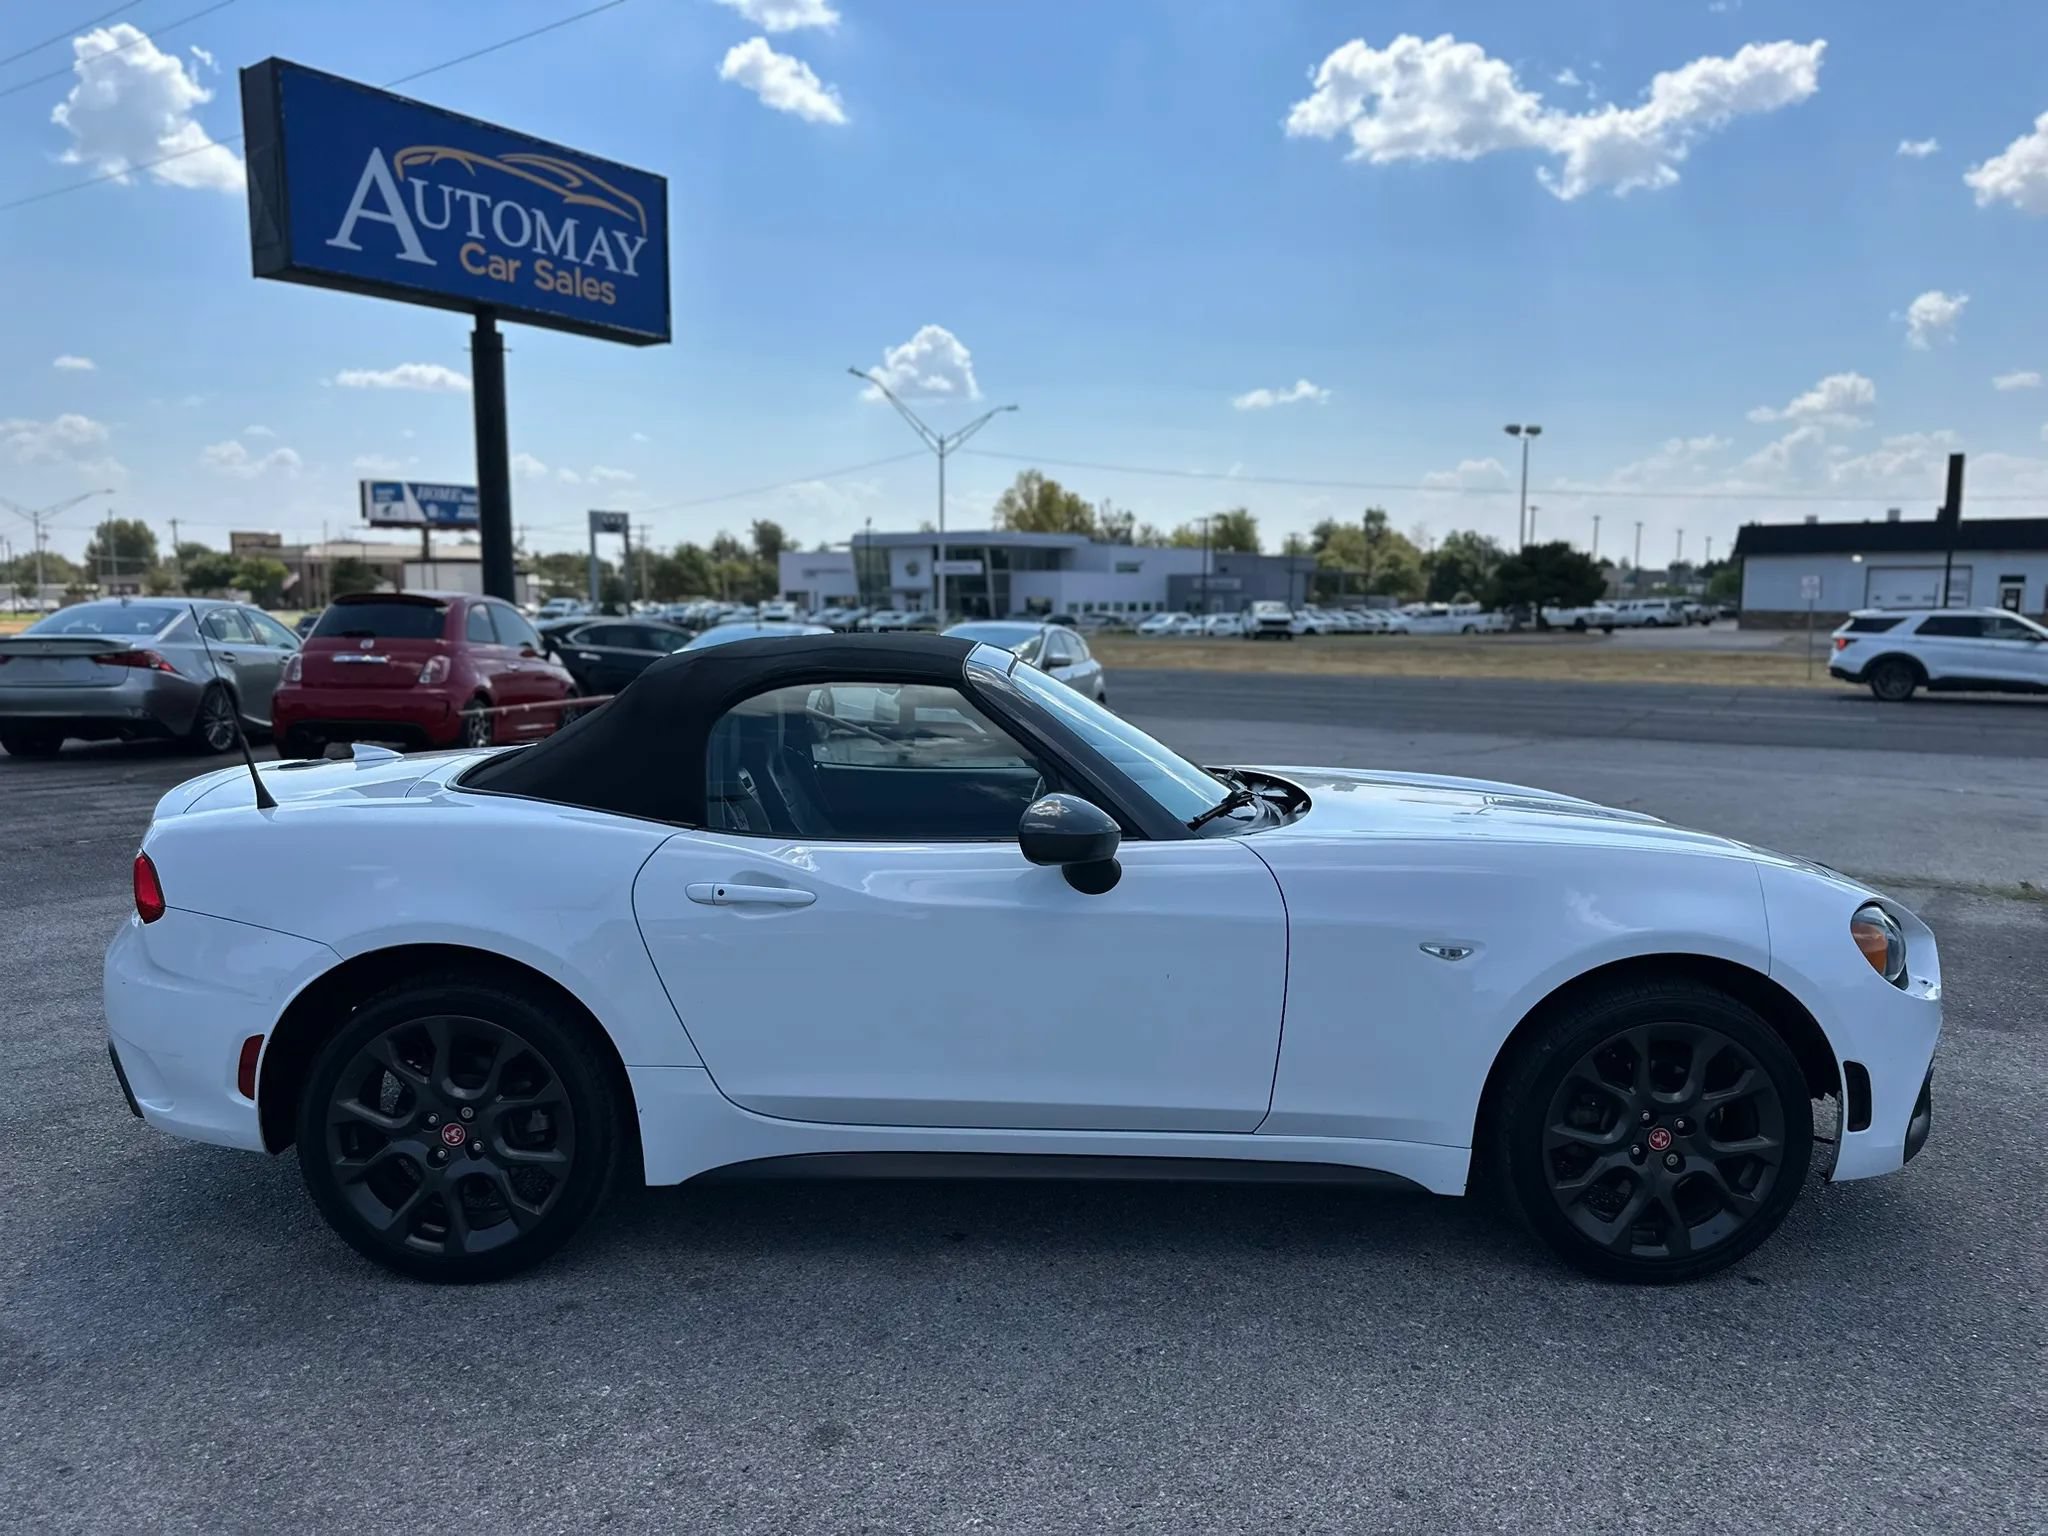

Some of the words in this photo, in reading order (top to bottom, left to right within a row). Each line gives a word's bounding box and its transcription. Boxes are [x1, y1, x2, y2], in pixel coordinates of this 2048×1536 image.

[326, 147, 648, 277] AUTOMAY
[459, 243, 522, 283] Car
[533, 258, 617, 305] Sales
